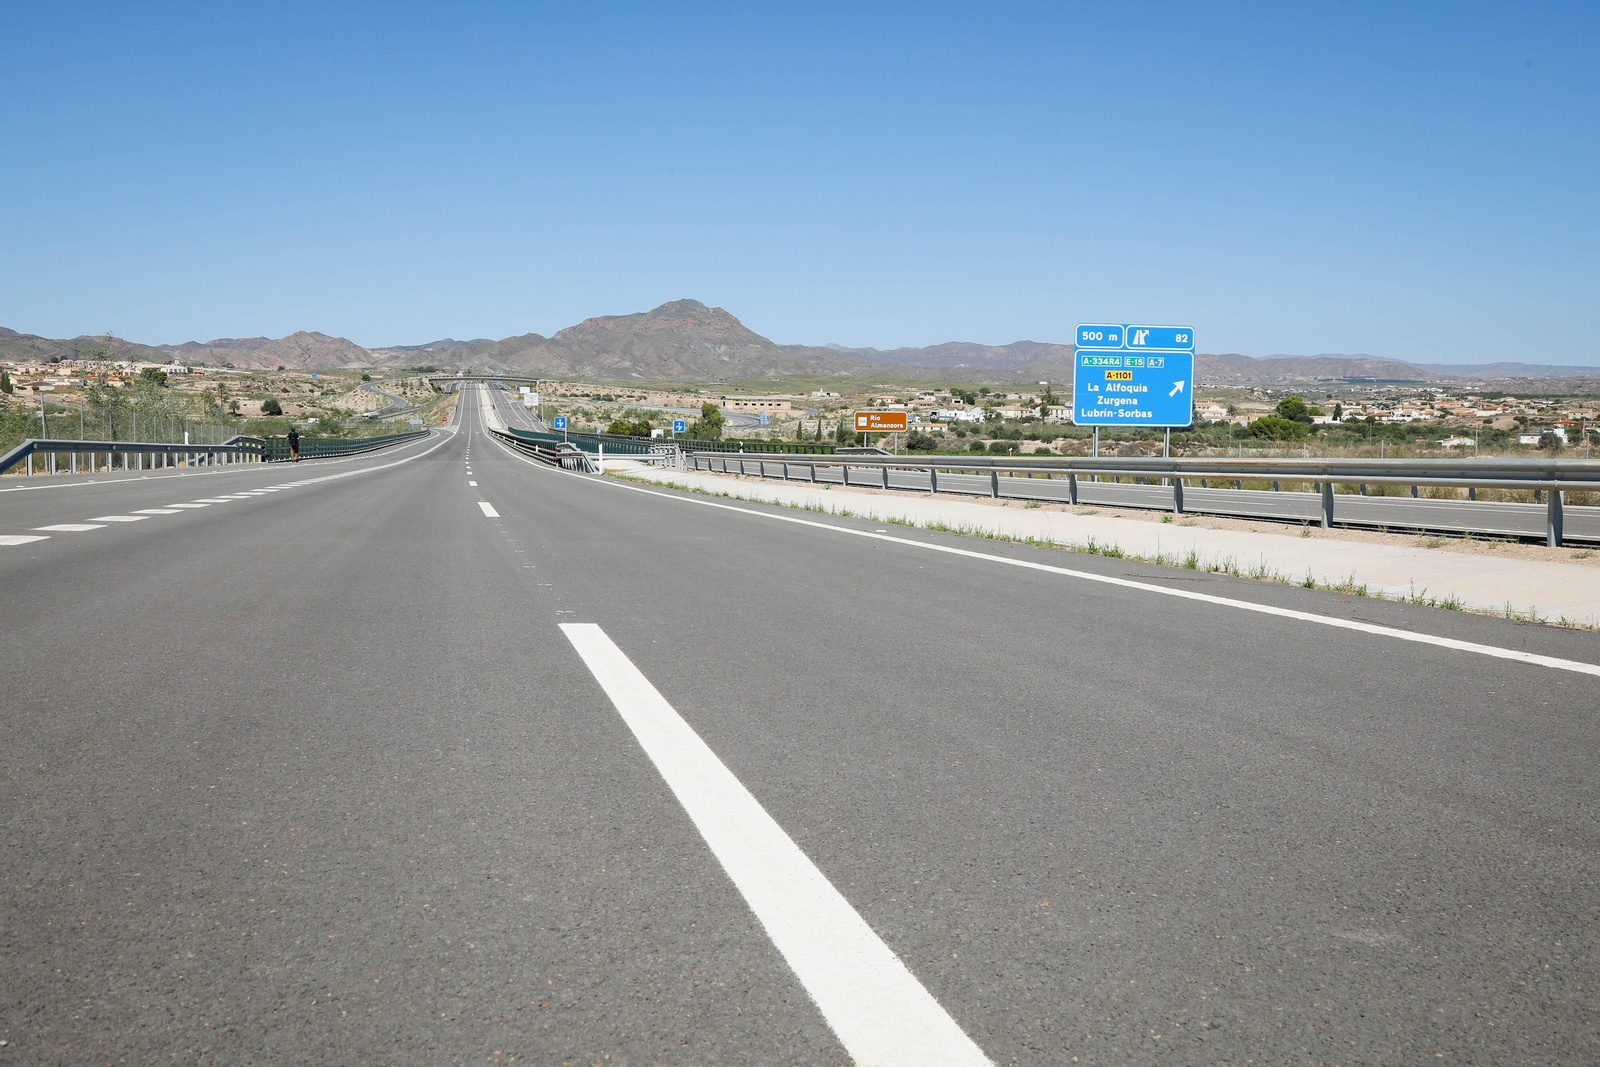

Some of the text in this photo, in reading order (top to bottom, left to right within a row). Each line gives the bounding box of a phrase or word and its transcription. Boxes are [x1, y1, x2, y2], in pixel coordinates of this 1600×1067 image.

[1082, 332, 1118, 341] 500 m
[1175, 334, 1188, 343] 82
[1083, 358, 1120, 366] A-334R4
[1126, 358, 1143, 366] E-15
[1149, 358, 1163, 366] A-7
[1087, 383, 1148, 394] La Alfoquía
[1097, 396, 1138, 406] Zurgena
[1081, 408, 1153, 418] Lubrín-Sorbas
